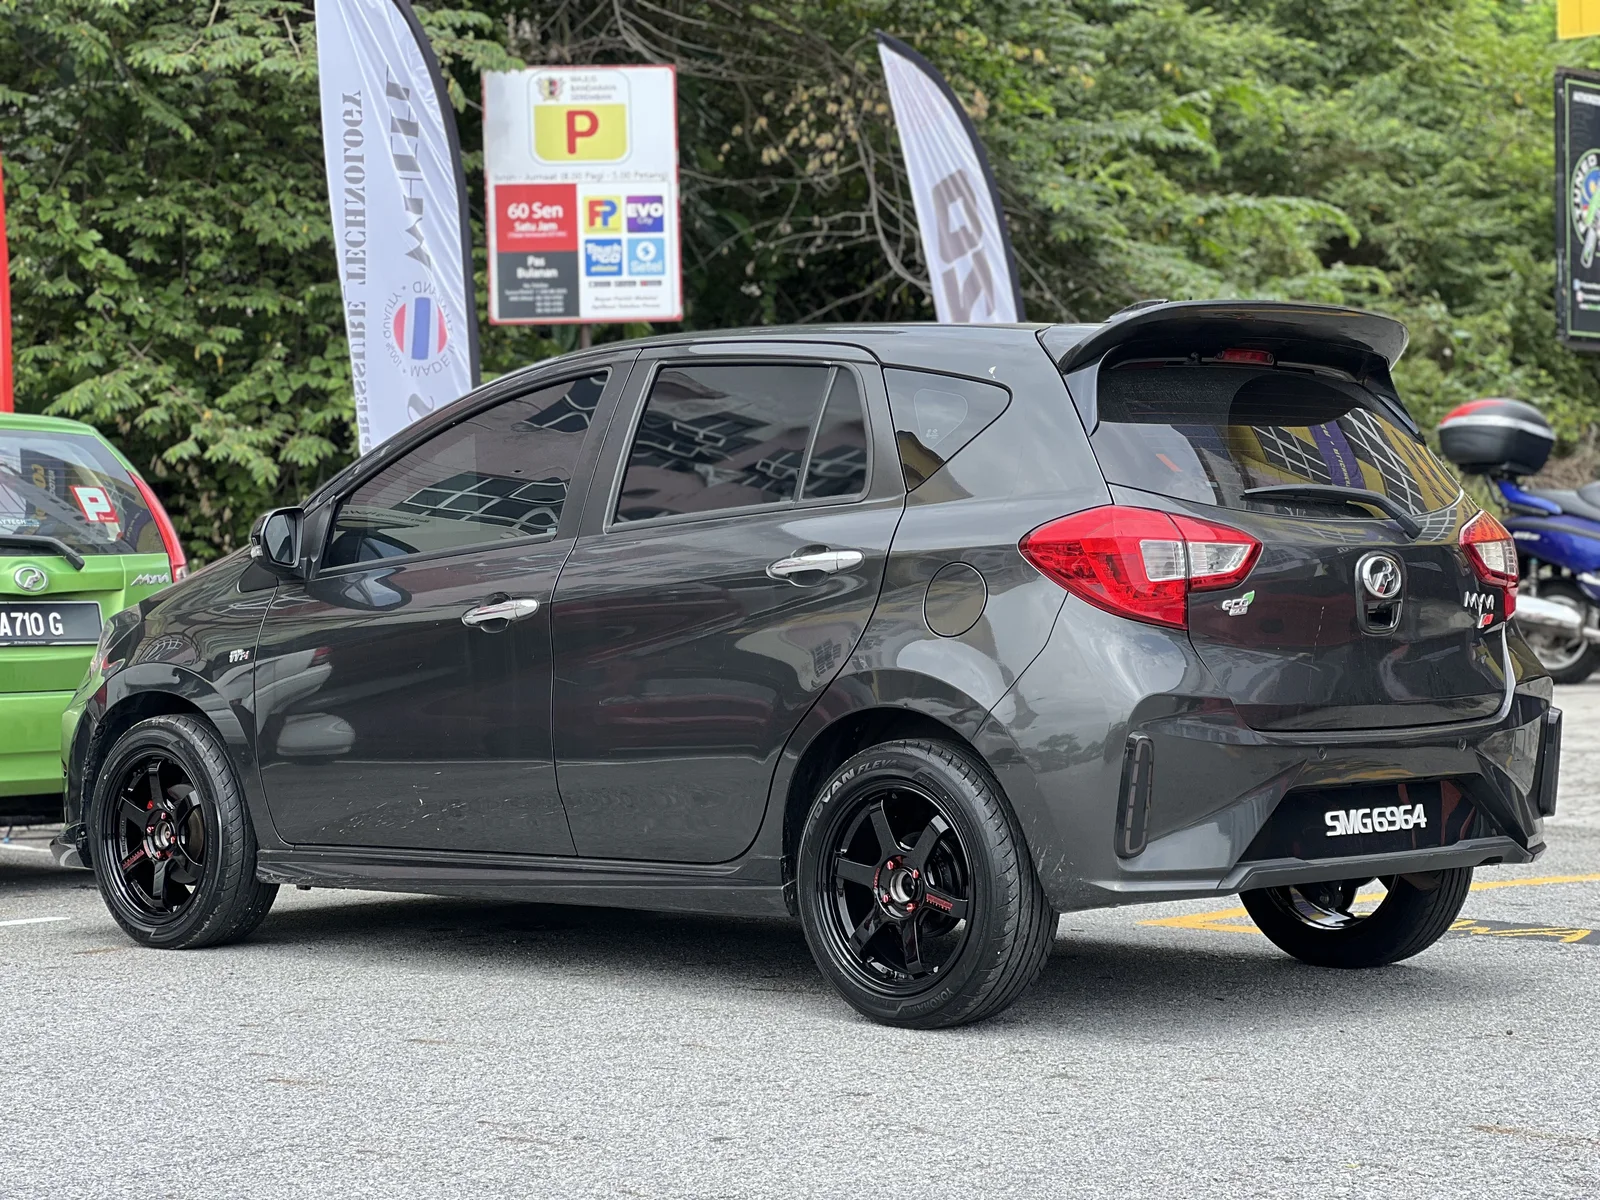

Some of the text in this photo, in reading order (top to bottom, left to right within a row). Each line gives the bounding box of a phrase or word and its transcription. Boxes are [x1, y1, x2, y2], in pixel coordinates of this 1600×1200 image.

[566, 110, 599, 155] P
[507, 201, 564, 219] 60 Sen
[627, 202, 663, 218] EVO
[74, 487, 111, 521] P
[49, 612, 64, 636] G
